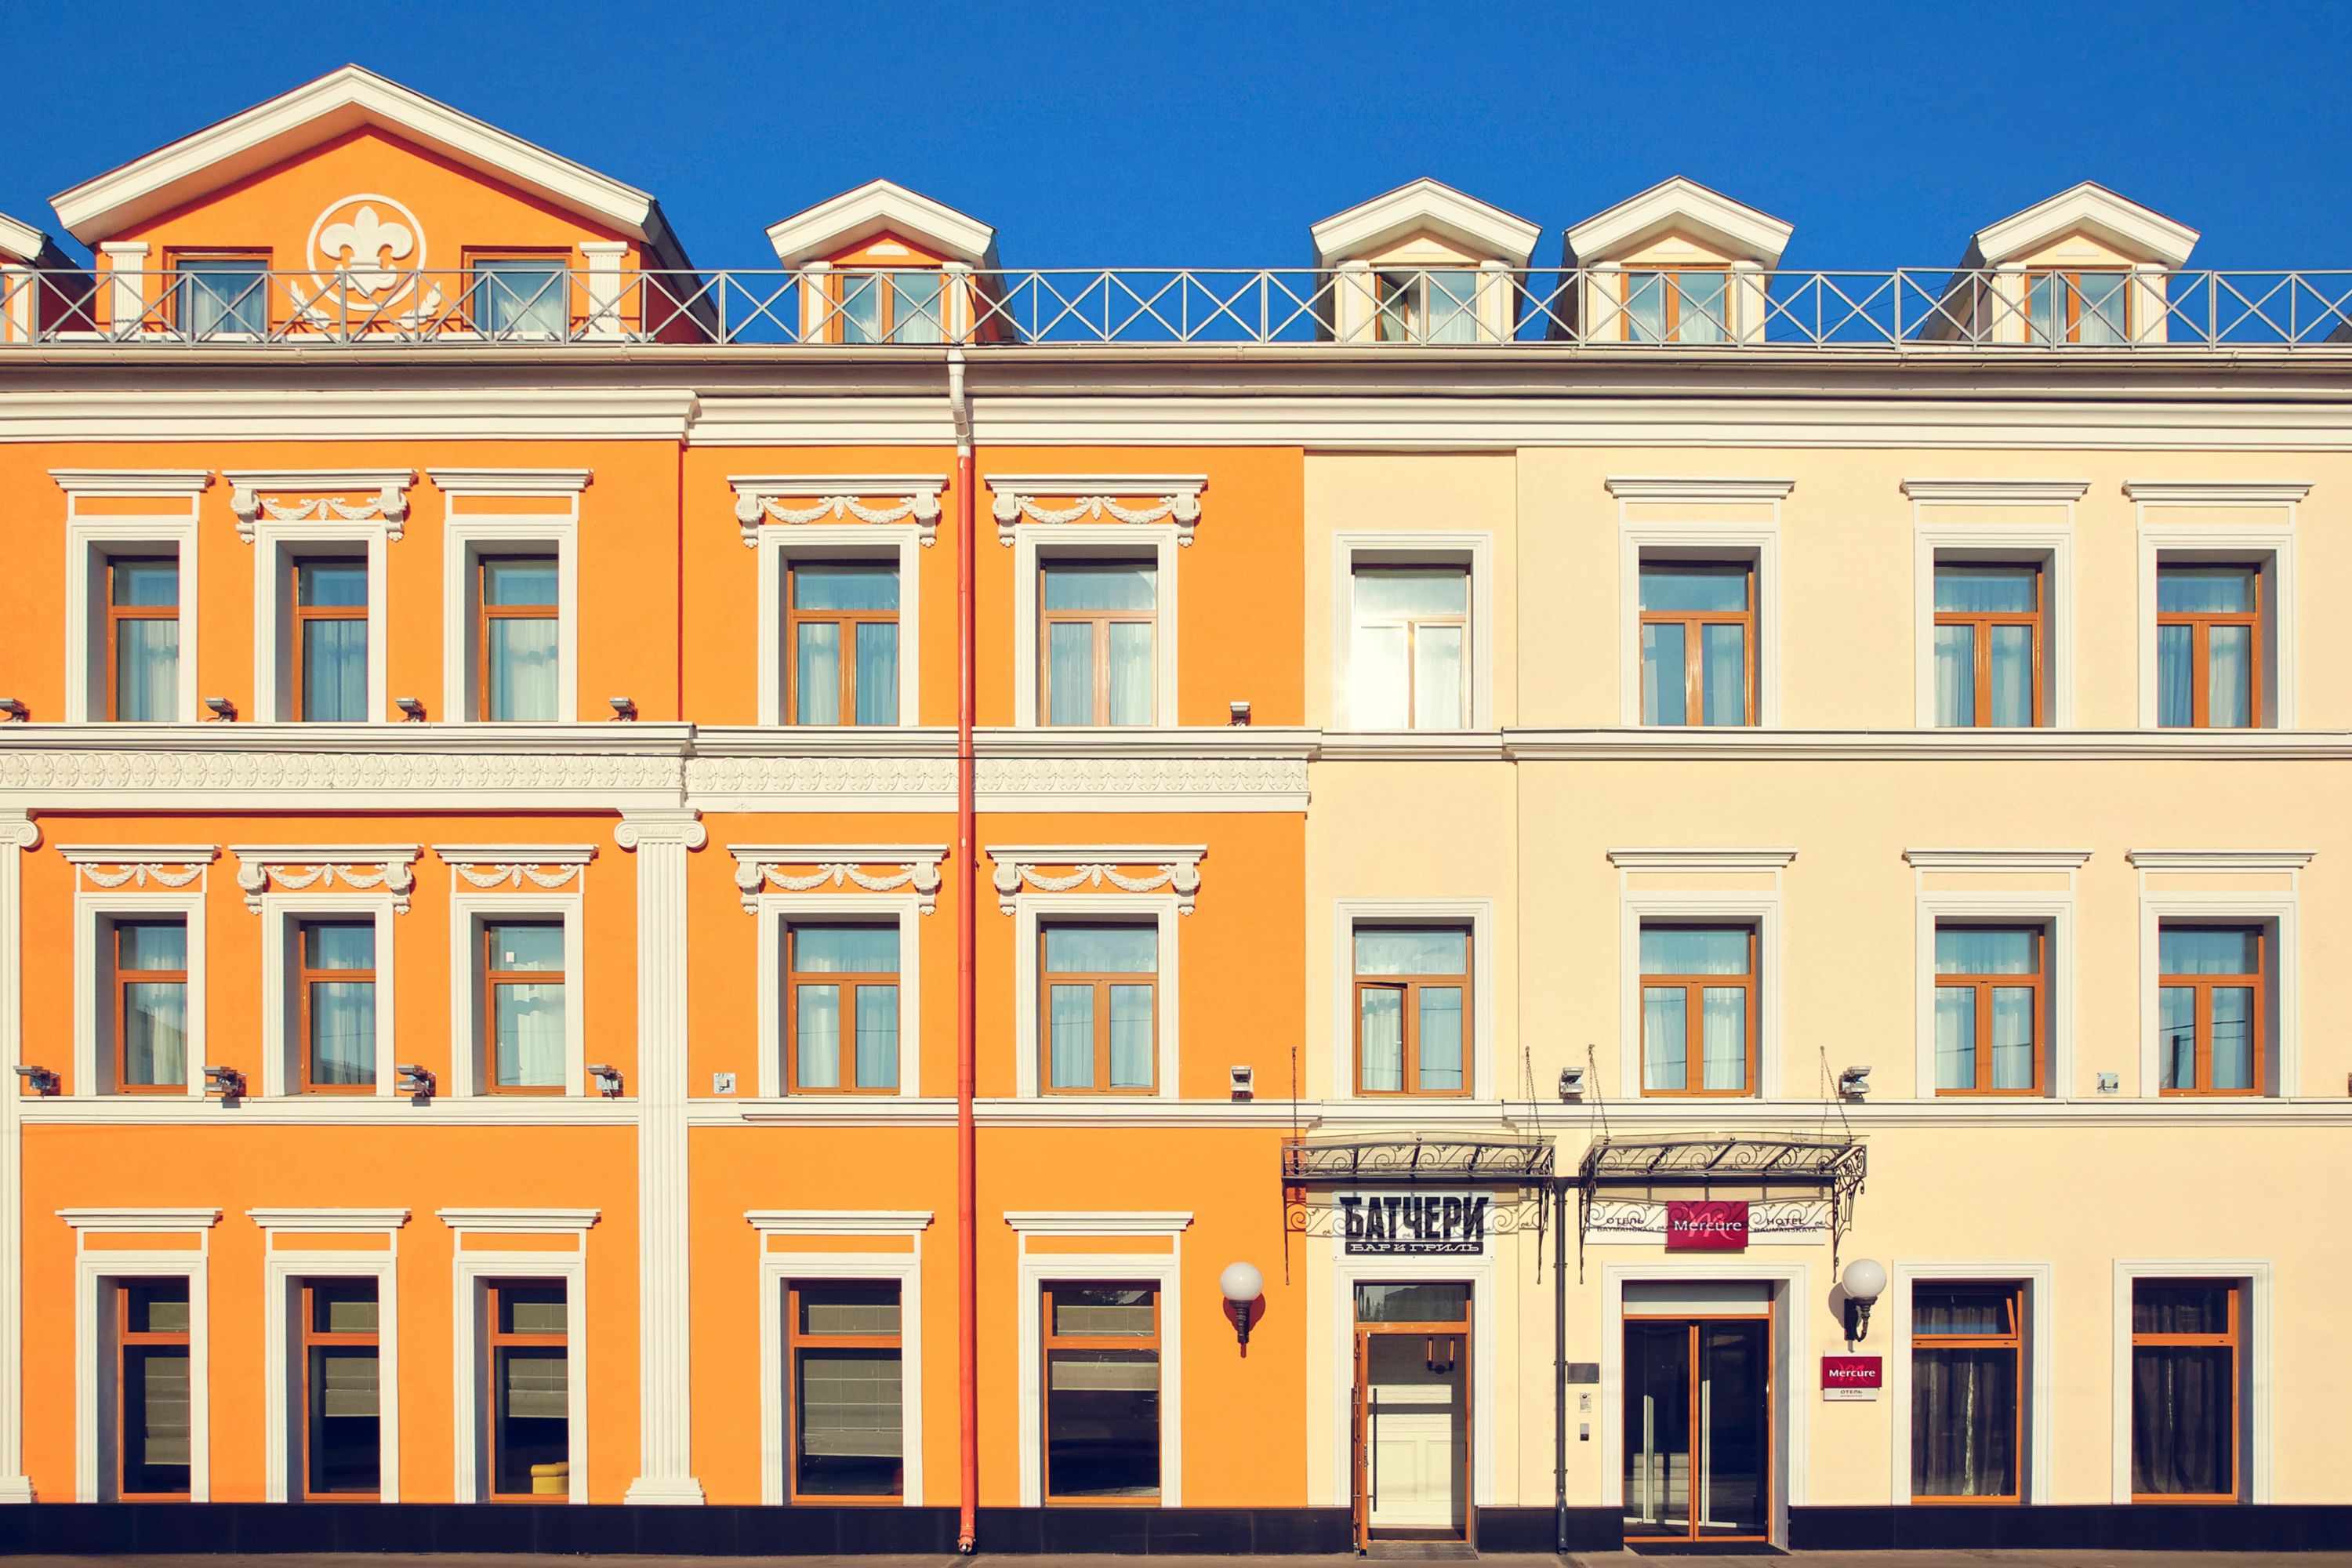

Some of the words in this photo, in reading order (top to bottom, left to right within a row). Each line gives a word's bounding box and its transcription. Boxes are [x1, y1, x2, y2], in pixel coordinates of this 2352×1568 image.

[1339, 1196, 1490, 1242] БАТЧЕРИ
[1674, 1220, 1742, 1232] Mercure
[1350, 1243, 1391, 1252] БАР
[1393, 1243, 1406, 1252] И
[1410, 1243, 1479, 1252] ГРИЛЬ
[1828, 1369, 1876, 1377] Mercure
